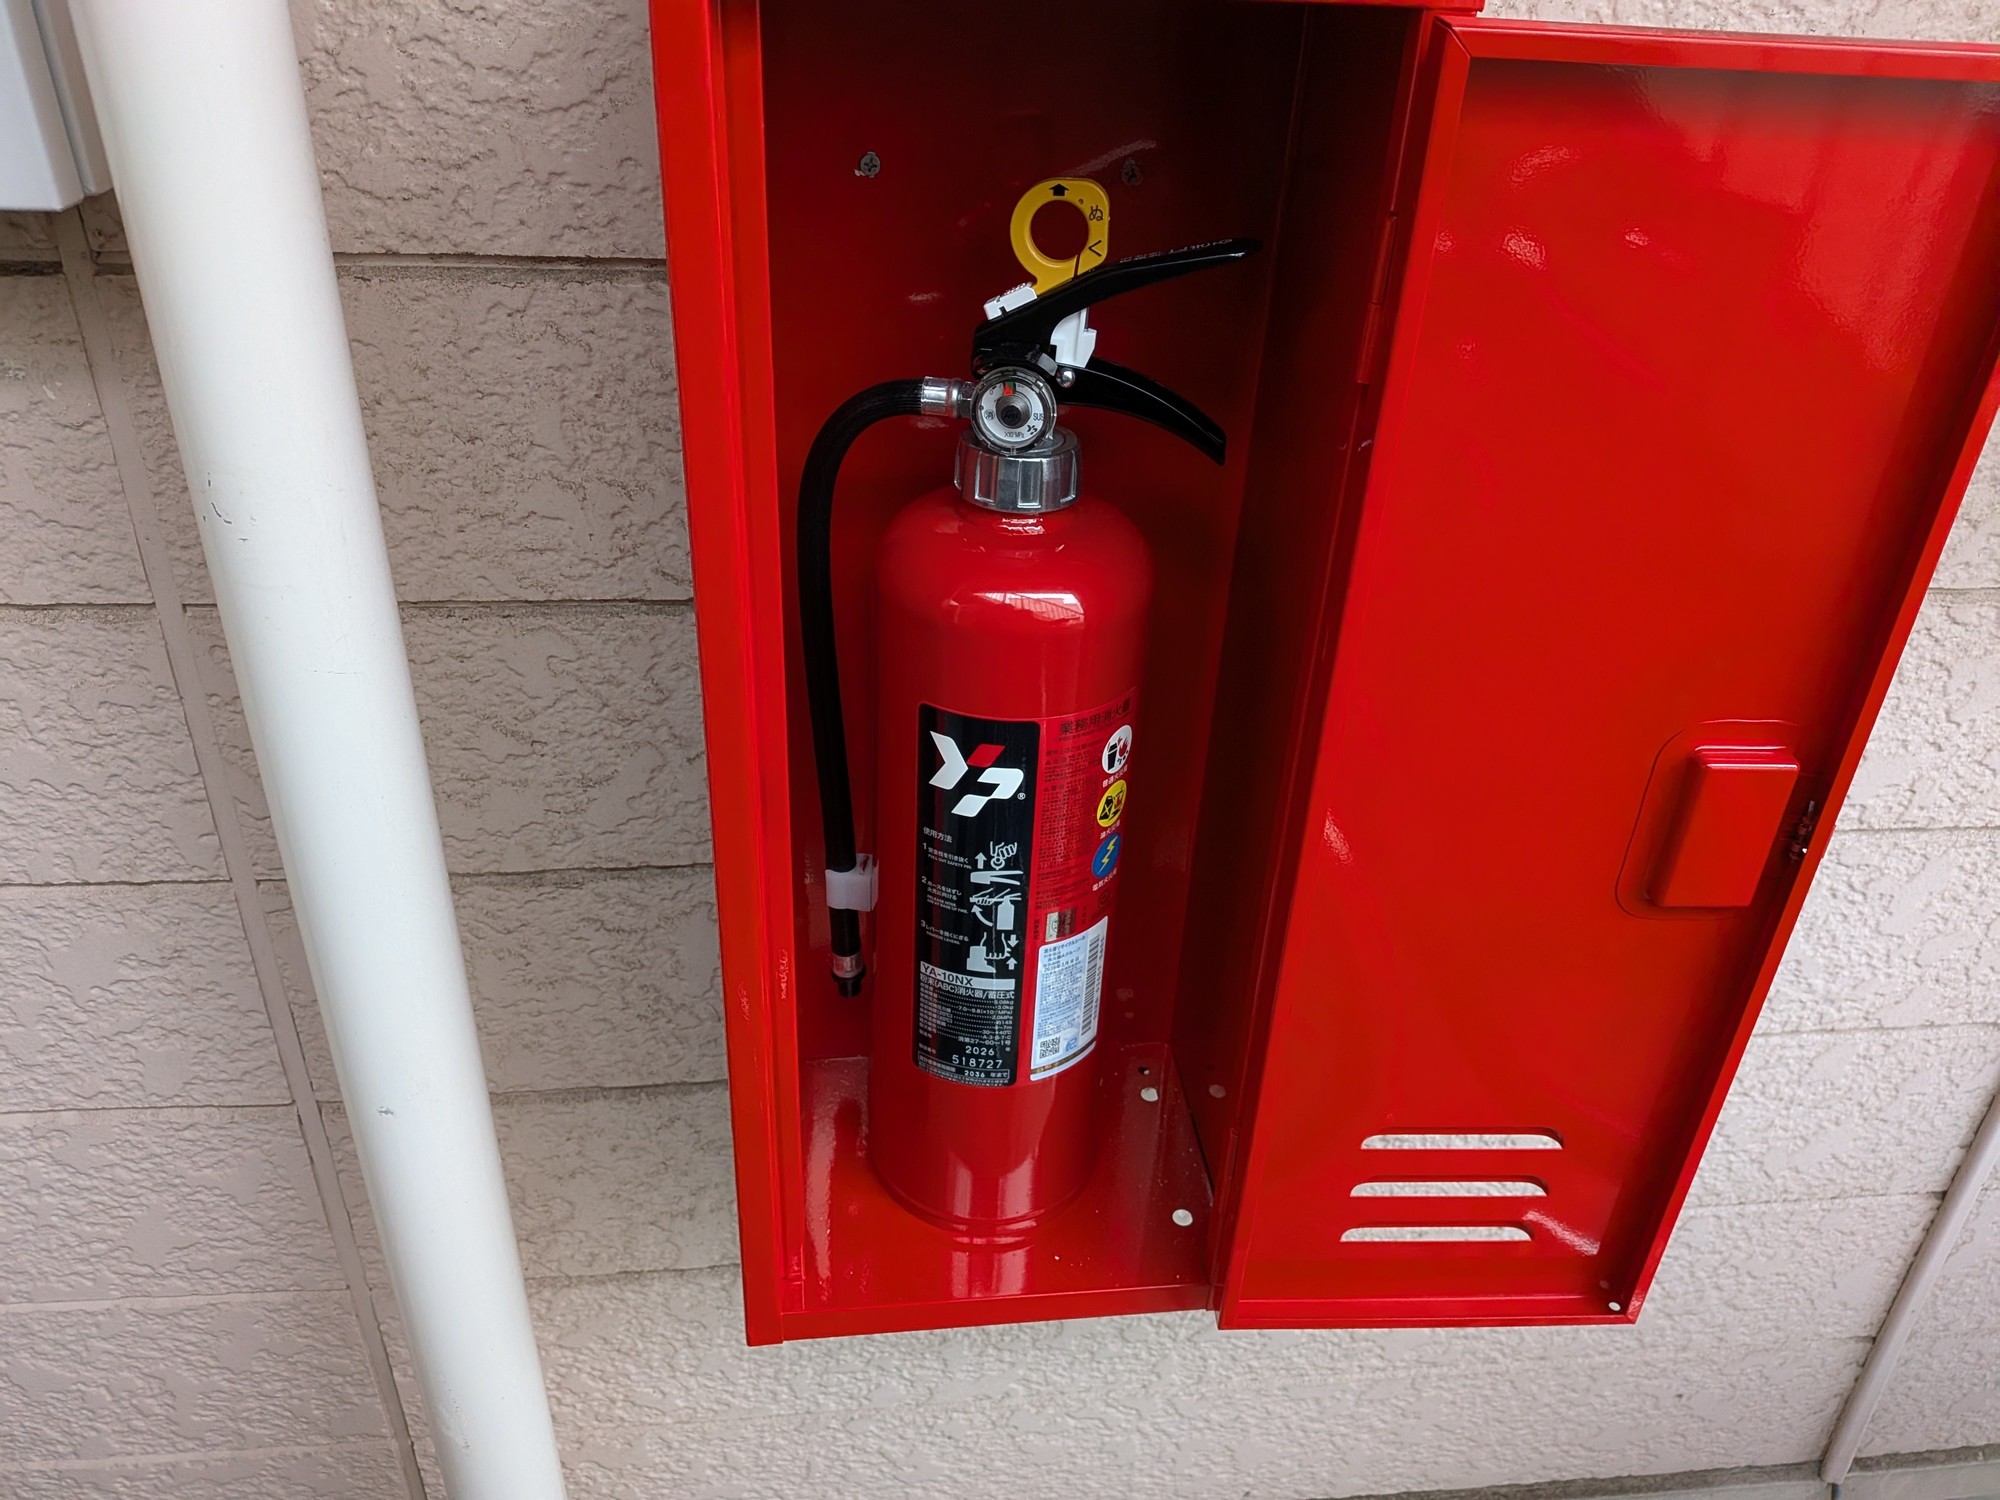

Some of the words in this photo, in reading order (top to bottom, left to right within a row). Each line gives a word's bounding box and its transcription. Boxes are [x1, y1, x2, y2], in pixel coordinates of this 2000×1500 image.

[923, 826, 952, 843] 使用方法
[920, 920, 926, 928] 3
[922, 963, 973, 986] YA-10NX
[965, 1045, 995, 1056] 2026
[952, 1054, 1003, 1069] 518727
[964, 1070, 985, 1078] 2036
